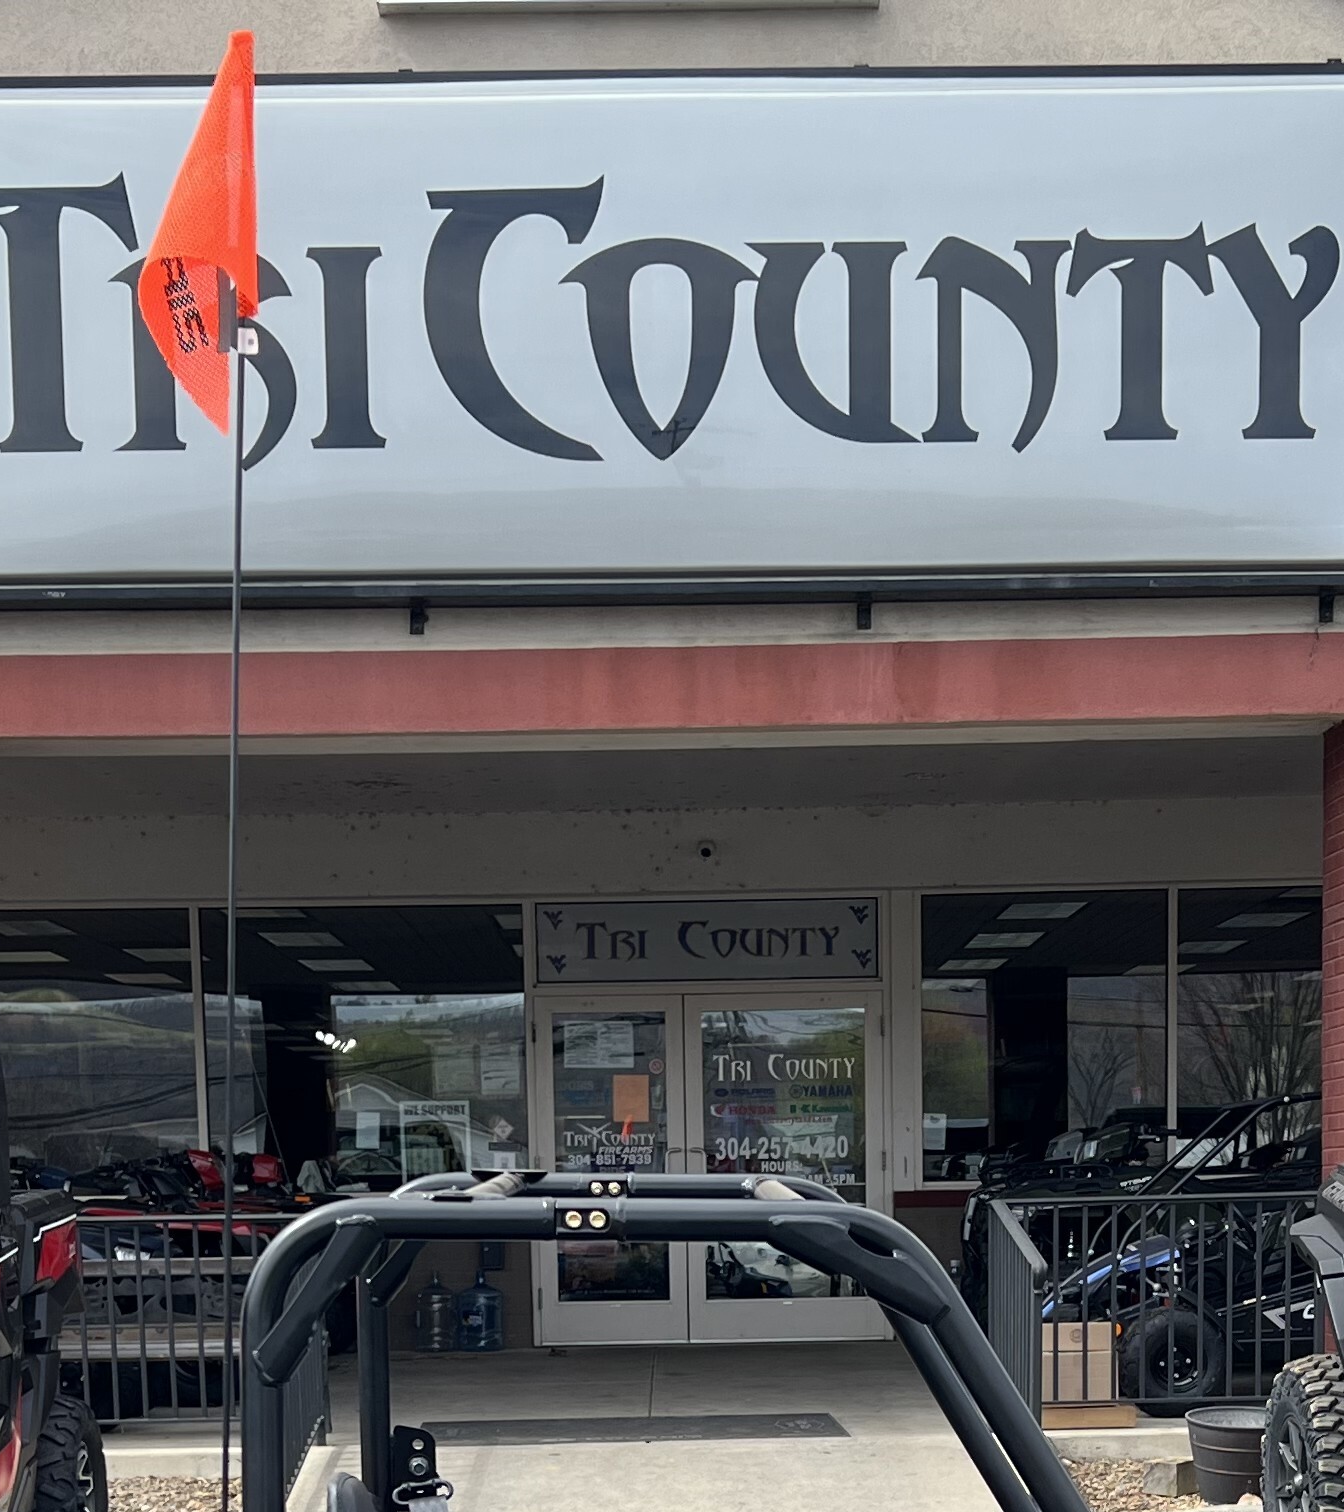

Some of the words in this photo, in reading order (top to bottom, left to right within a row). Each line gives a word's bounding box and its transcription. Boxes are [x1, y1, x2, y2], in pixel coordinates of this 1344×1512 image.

[423, 173, 1342, 463] COUNTY
[575, 921, 648, 962] TRI
[677, 920, 840, 960] COUNTY
[712, 1054, 752, 1082] TRI
[767, 1053, 855, 1081] COUNTY
[803, 1084, 853, 1098] YAMAHA
[420, 1104, 467, 1116] SUPPORT
[729, 1104, 776, 1116] HONDA
[598, 1146, 653, 1155] FIREARMS
[567, 1154, 652, 1166] 304-851-7939
